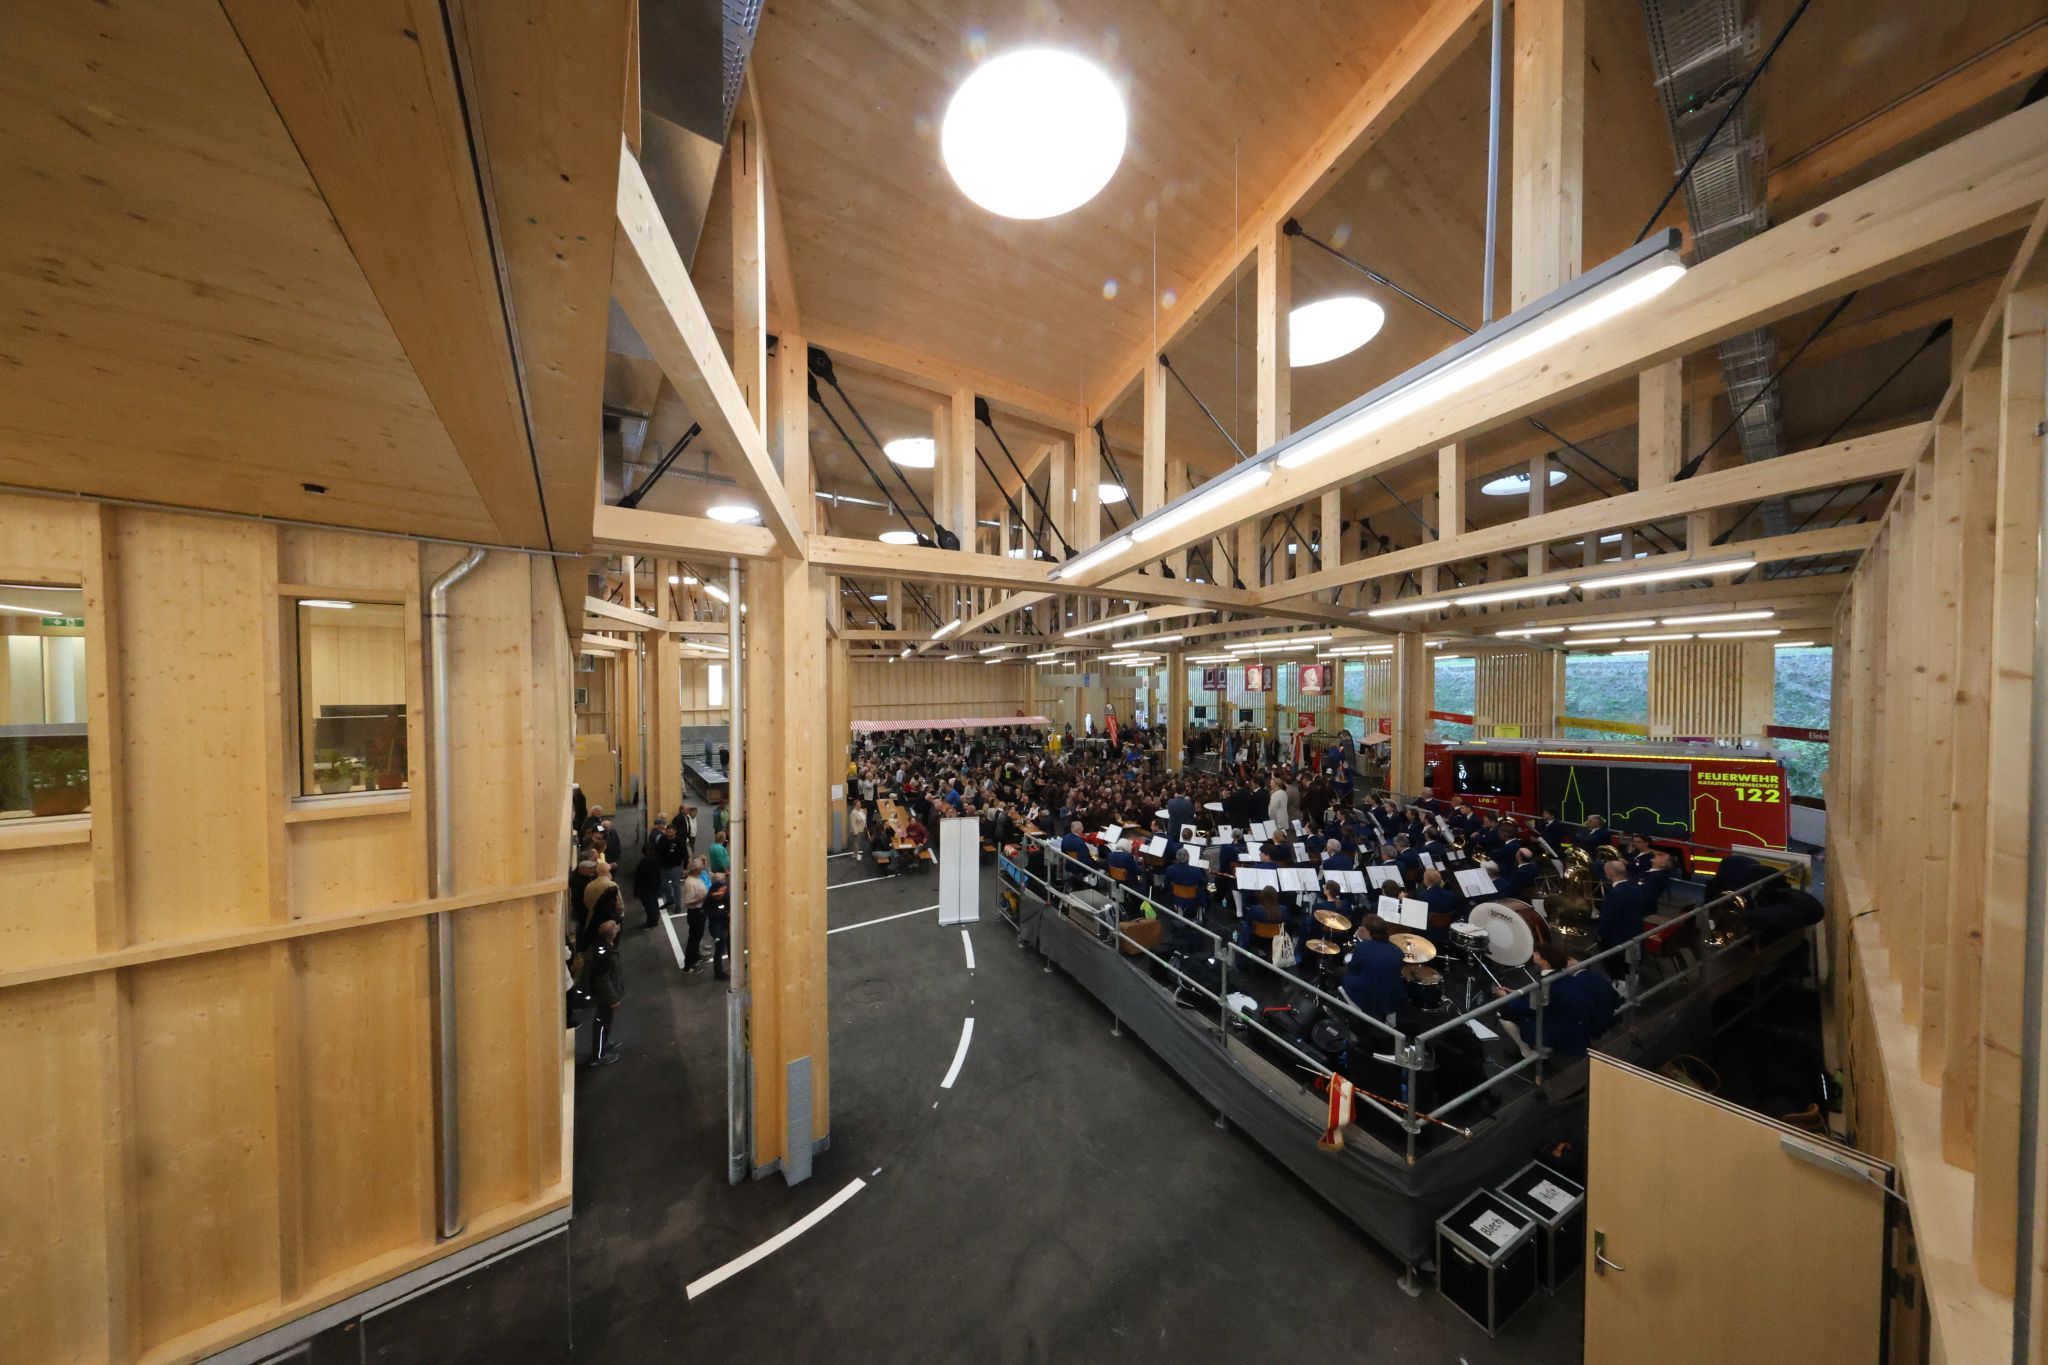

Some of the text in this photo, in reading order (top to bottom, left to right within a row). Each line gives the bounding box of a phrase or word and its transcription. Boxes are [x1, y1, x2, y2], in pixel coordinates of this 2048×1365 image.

[1697, 772, 1779, 783] FEUERWEHR
[1697, 780, 1779, 789] KATASTROPHENSCHUTZ
[1735, 787, 1780, 803] 122
[1480, 1217, 1505, 1236] Blech
